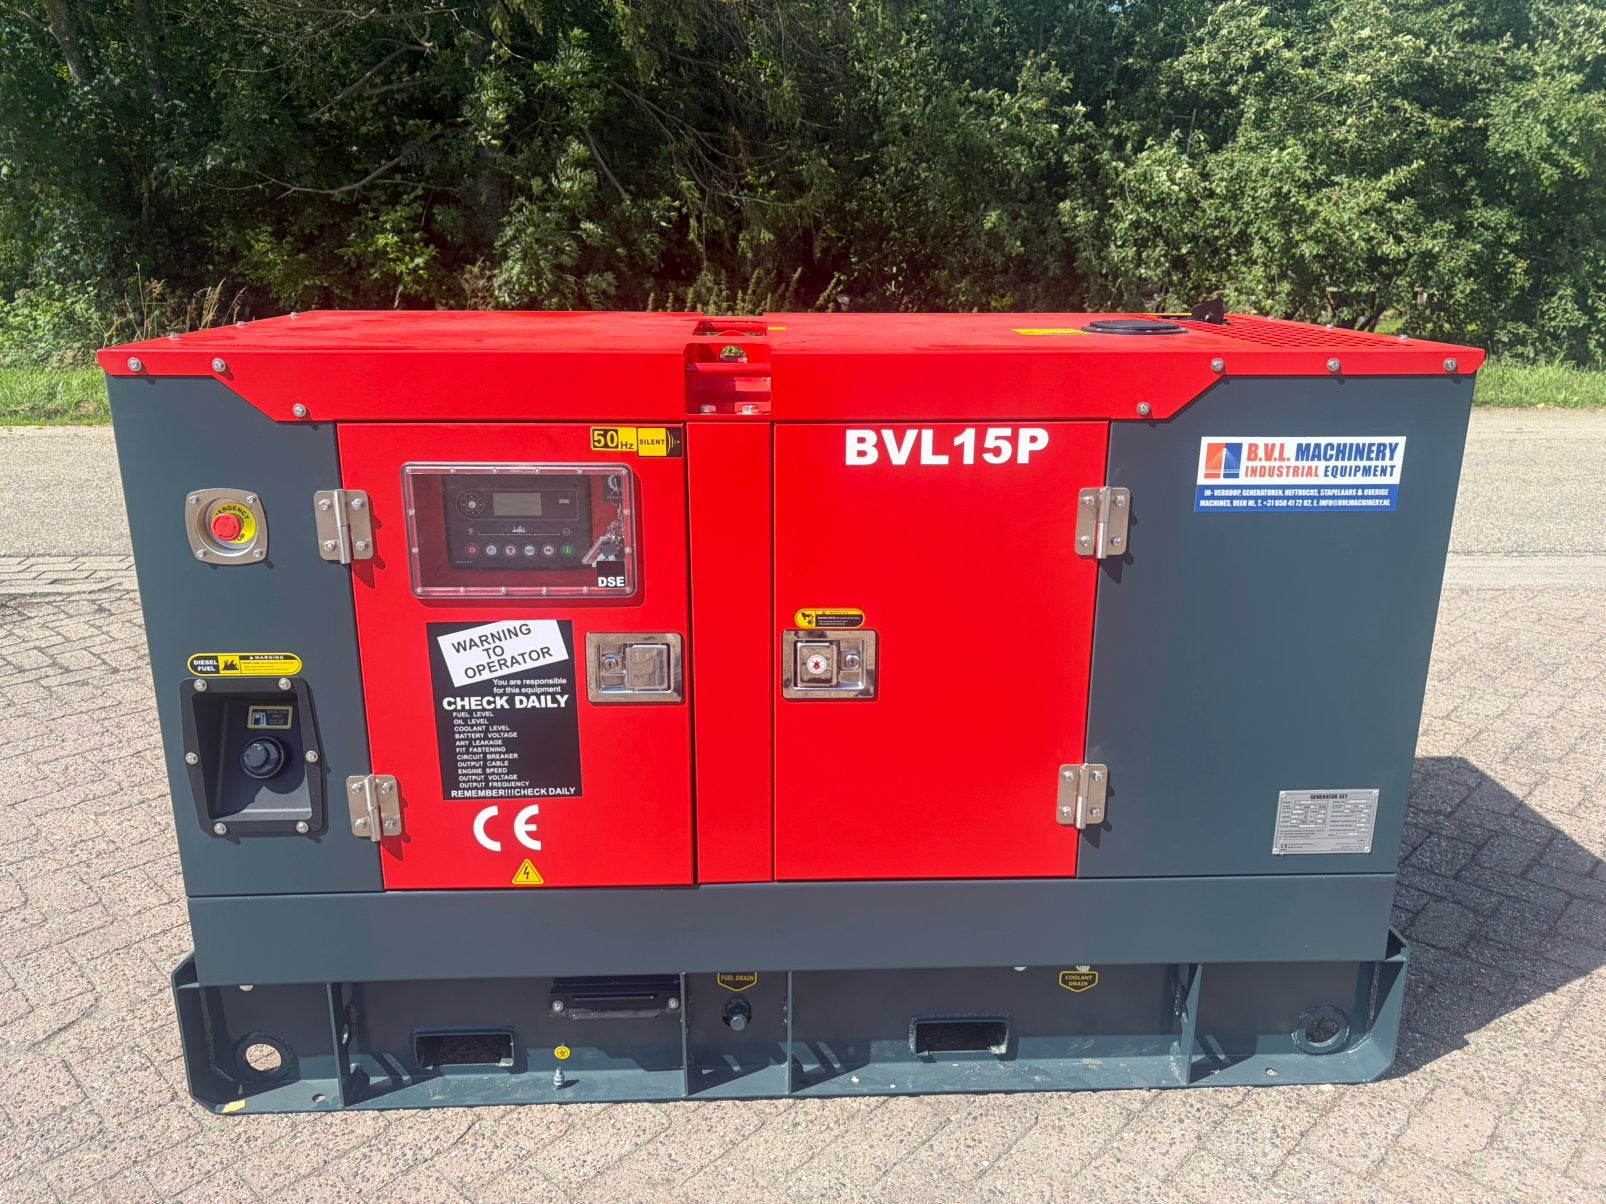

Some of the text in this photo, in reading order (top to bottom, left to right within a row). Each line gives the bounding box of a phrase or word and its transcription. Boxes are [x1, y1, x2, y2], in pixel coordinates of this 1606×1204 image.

[639, 438, 665, 446] SILENT
[845, 427, 1049, 466] BVL15P
[1246, 442, 1400, 462] B.V.L. MACHINERY
[1244, 465, 1396, 479] INDUSTRIAL EQUIPMENT
[1320, 488, 1357, 496] STAPELAARS
[1363, 488, 1389, 496] OVERIGE
[215, 505, 250, 520] ERGENCY
[598, 576, 625, 587] DSE
[451, 623, 532, 654] WARNING
[482, 645, 505, 660] TO
[464, 646, 553, 679] OPERATOR
[523, 677, 568, 687] responsible
[521, 686, 561, 694] equipment
[442, 694, 570, 710] CHECK DAILY
[549, 787, 576, 796] DAILY
